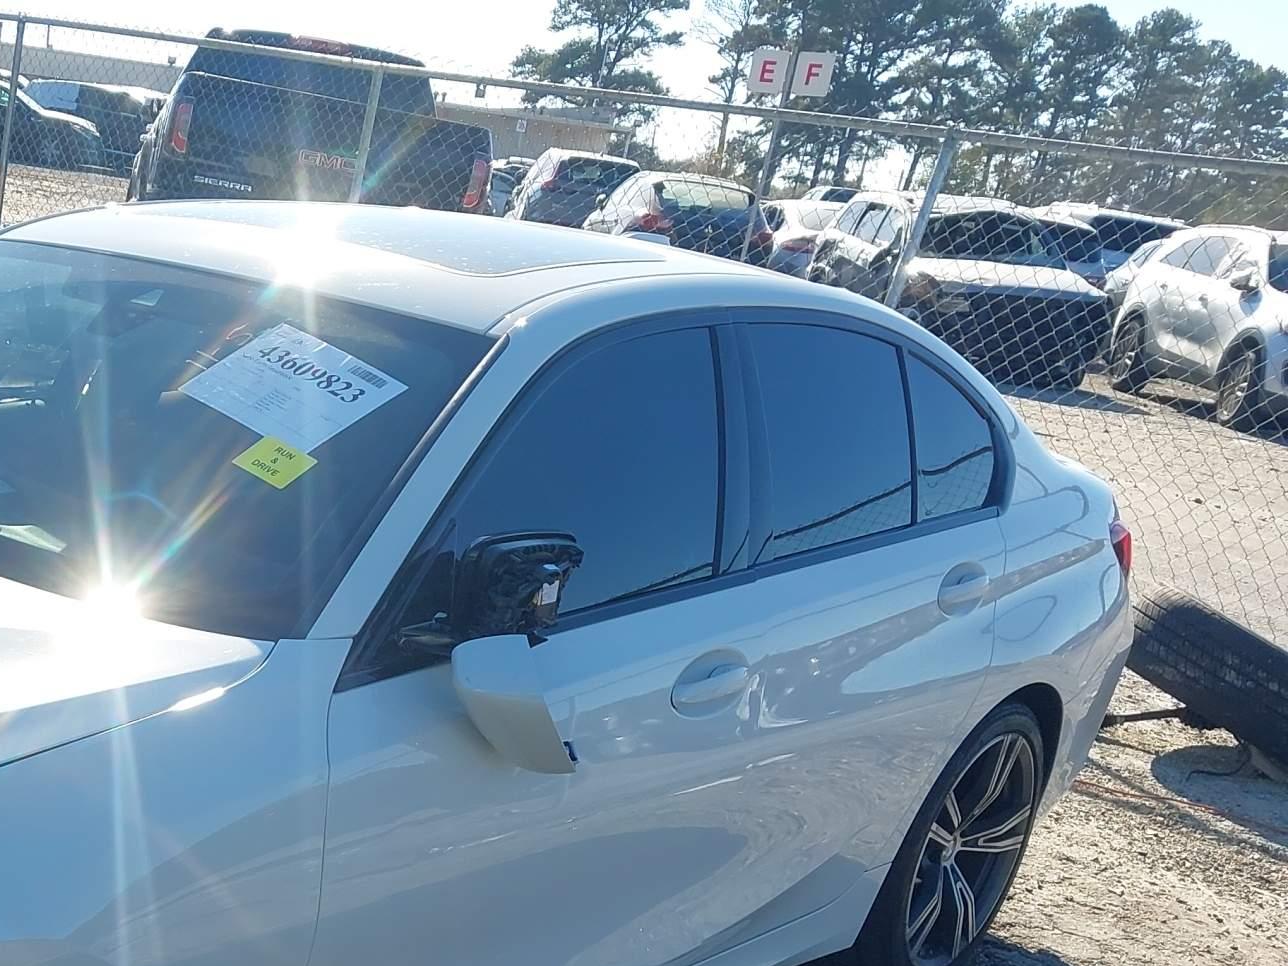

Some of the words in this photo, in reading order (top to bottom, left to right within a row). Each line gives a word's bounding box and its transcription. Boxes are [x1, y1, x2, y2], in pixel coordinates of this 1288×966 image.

[759, 60, 777, 83] E
[804, 63, 823, 86] F
[298, 149, 360, 171] GMC
[193, 175, 253, 192] SIERRA
[258, 346, 366, 403] 43609823
[274, 446, 296, 461] RUN
[251, 459, 280, 477] DRIVE
